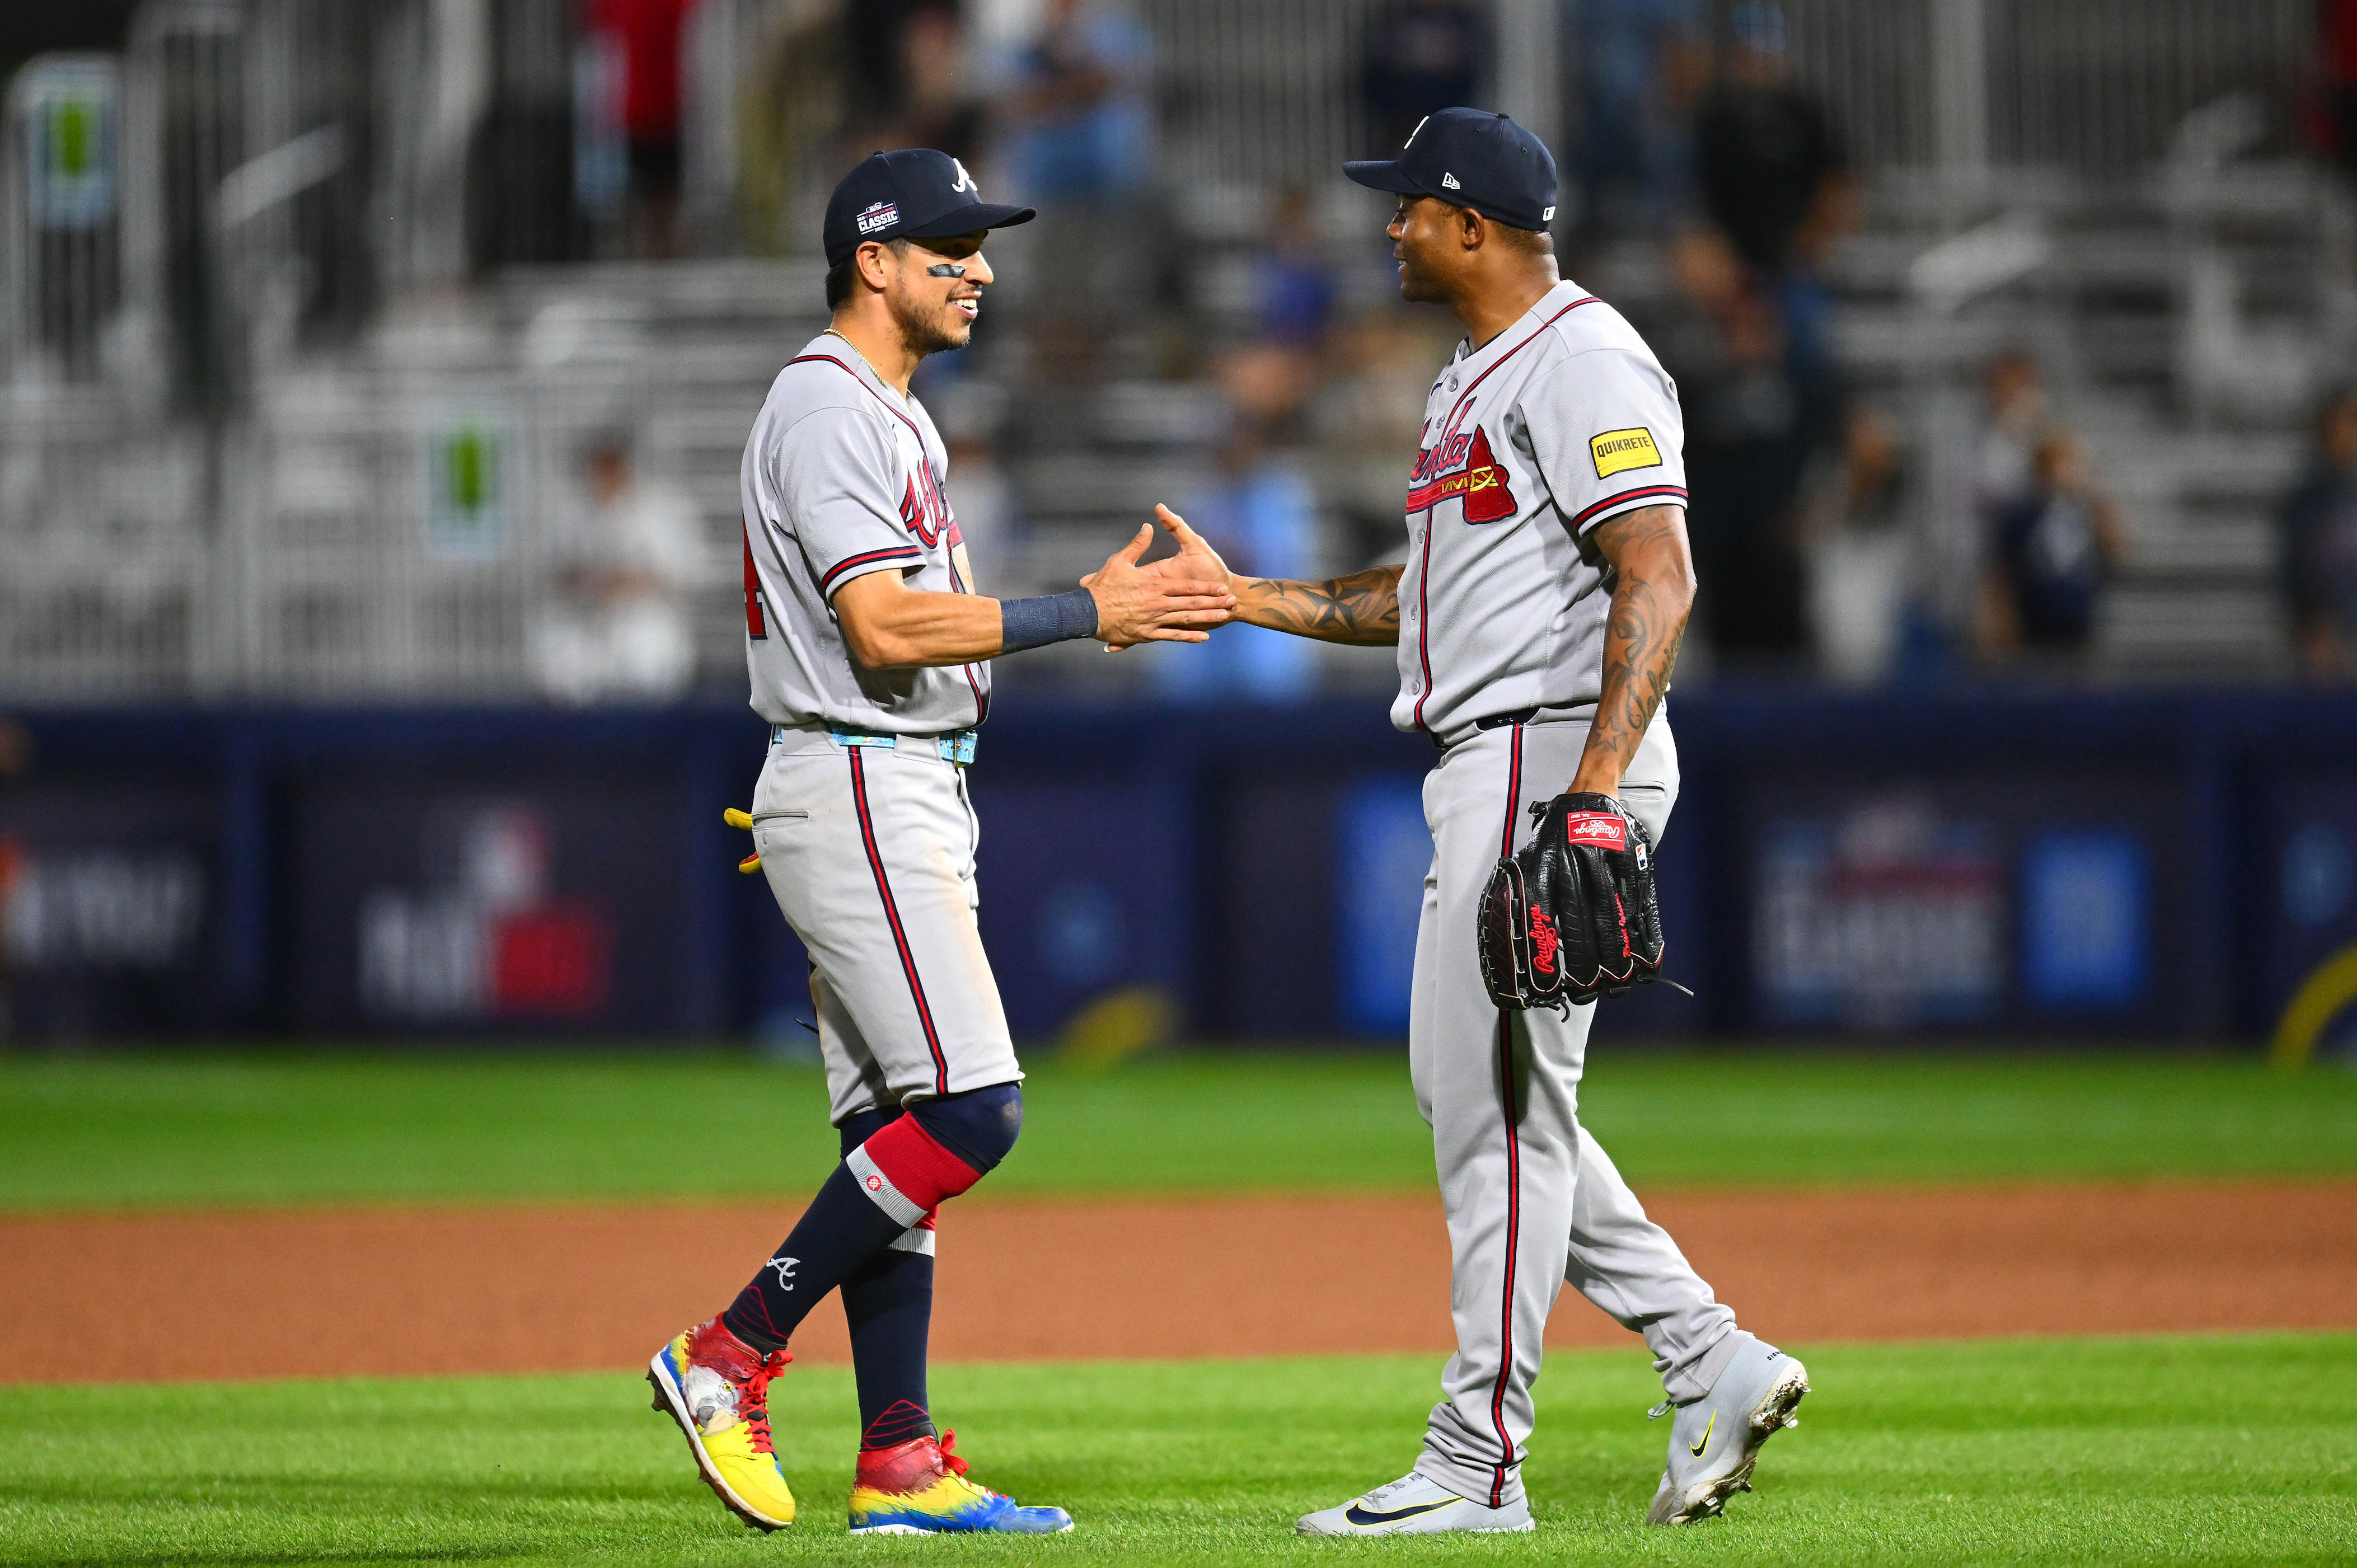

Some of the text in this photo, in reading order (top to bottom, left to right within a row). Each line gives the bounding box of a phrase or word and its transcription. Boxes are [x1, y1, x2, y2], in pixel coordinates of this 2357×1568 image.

[858, 210, 898, 232] CLASSIC
[1596, 436, 1651, 458] QUIKRETE
[1573, 822, 1620, 839] Rawlings
[1529, 903, 1555, 974] Rawlings
